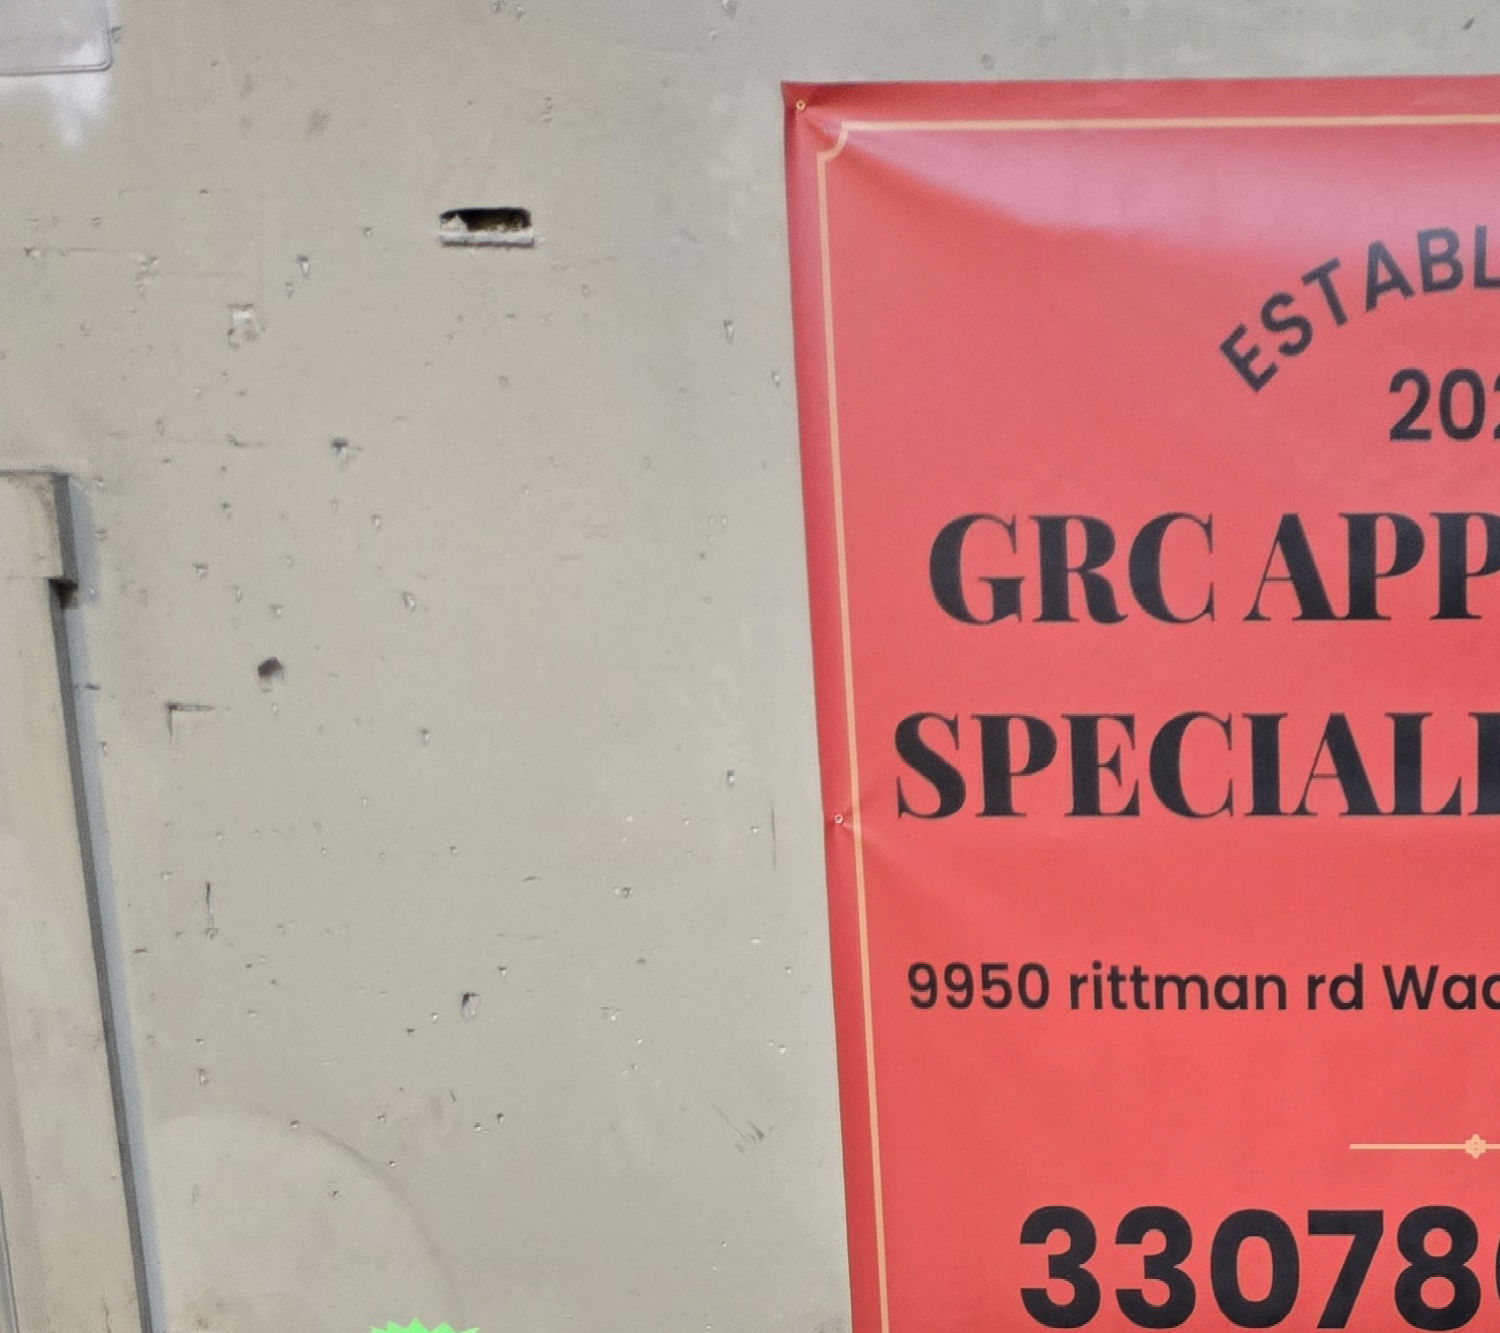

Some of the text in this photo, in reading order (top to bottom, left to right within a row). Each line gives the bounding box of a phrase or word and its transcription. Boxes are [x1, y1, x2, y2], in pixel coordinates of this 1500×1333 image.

[928, 512, 1215, 625] GRC
[906, 962, 1050, 1011] 9950
[1067, 964, 1287, 1011] rittman
[1306, 962, 1363, 1011] rd
